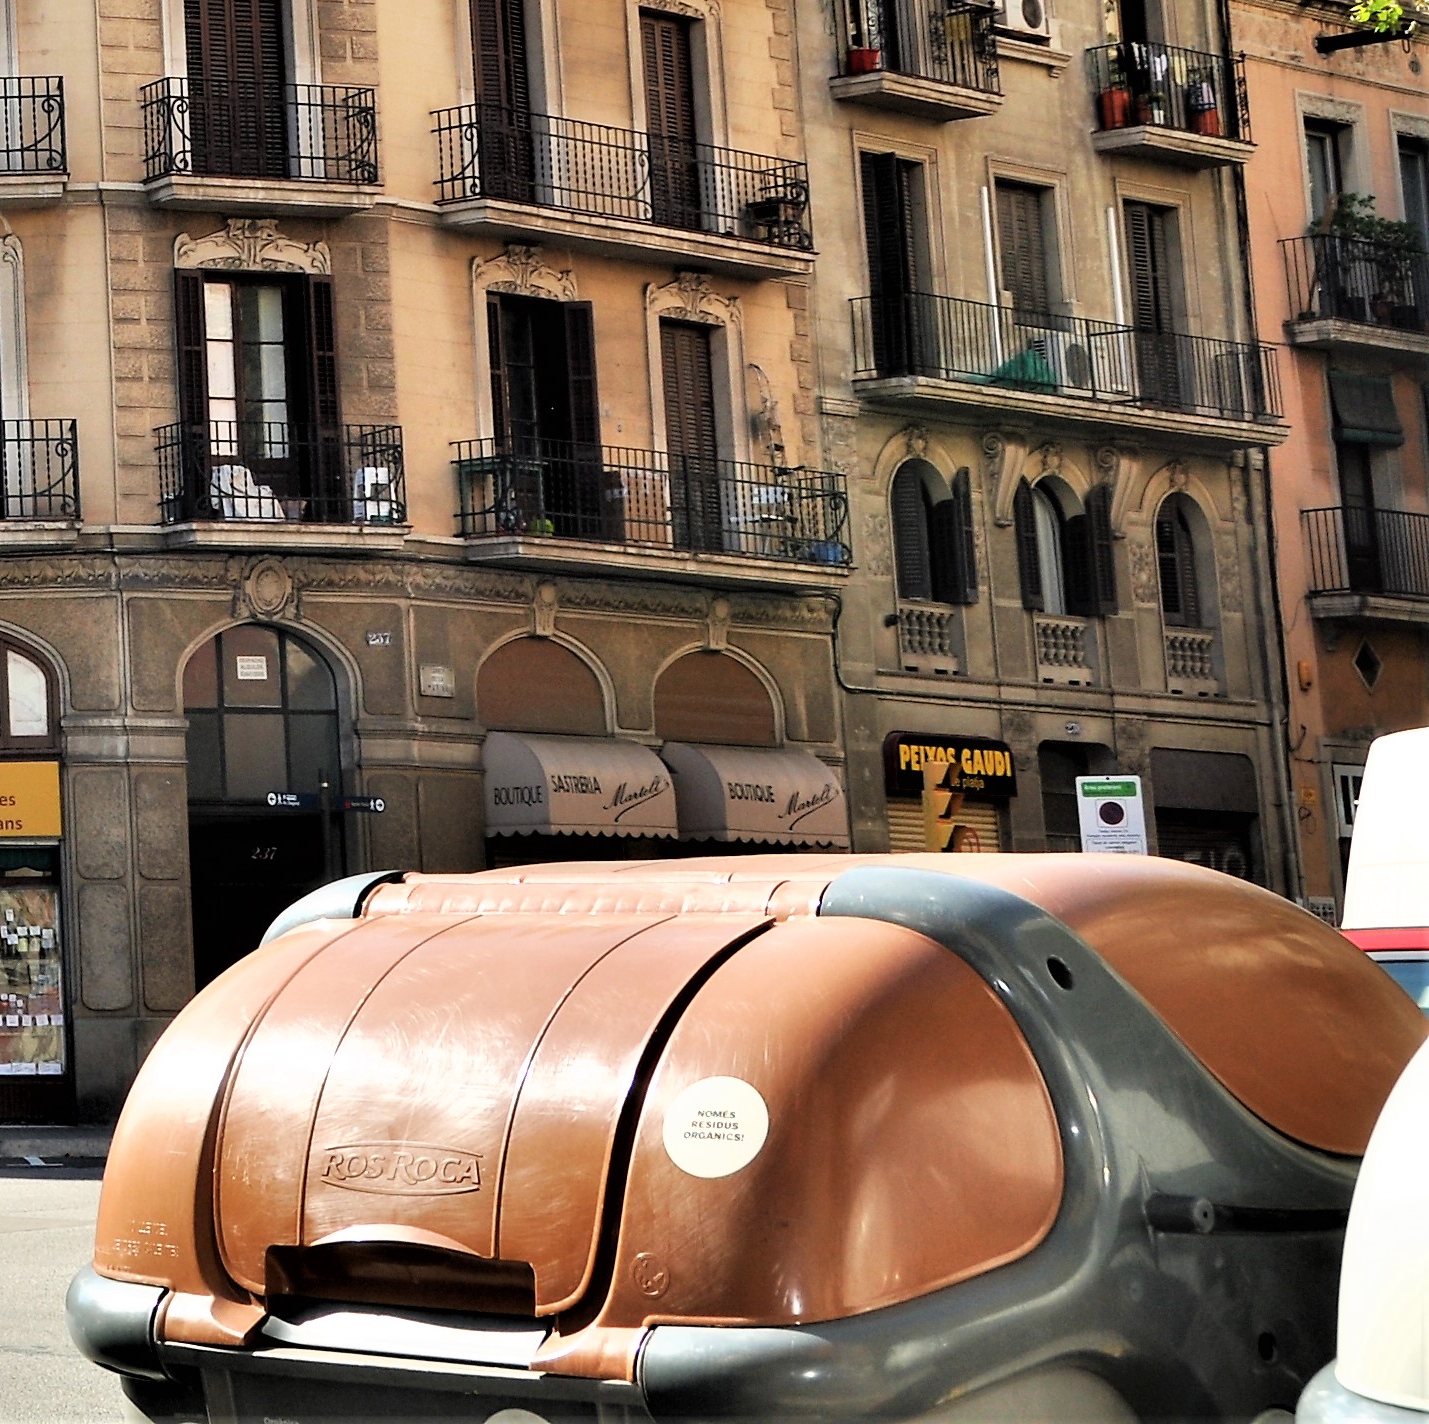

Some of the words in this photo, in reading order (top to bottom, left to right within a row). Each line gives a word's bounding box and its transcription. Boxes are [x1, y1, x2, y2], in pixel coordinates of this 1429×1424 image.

[961, 748, 1012, 777] GAUDI
[493, 784, 543, 807] BOUTIQUE
[550, 774, 603, 795] SASTRERIA
[727, 781, 776, 804] BOUTIQUE
[691, 1120, 740, 1131] RESIDUS
